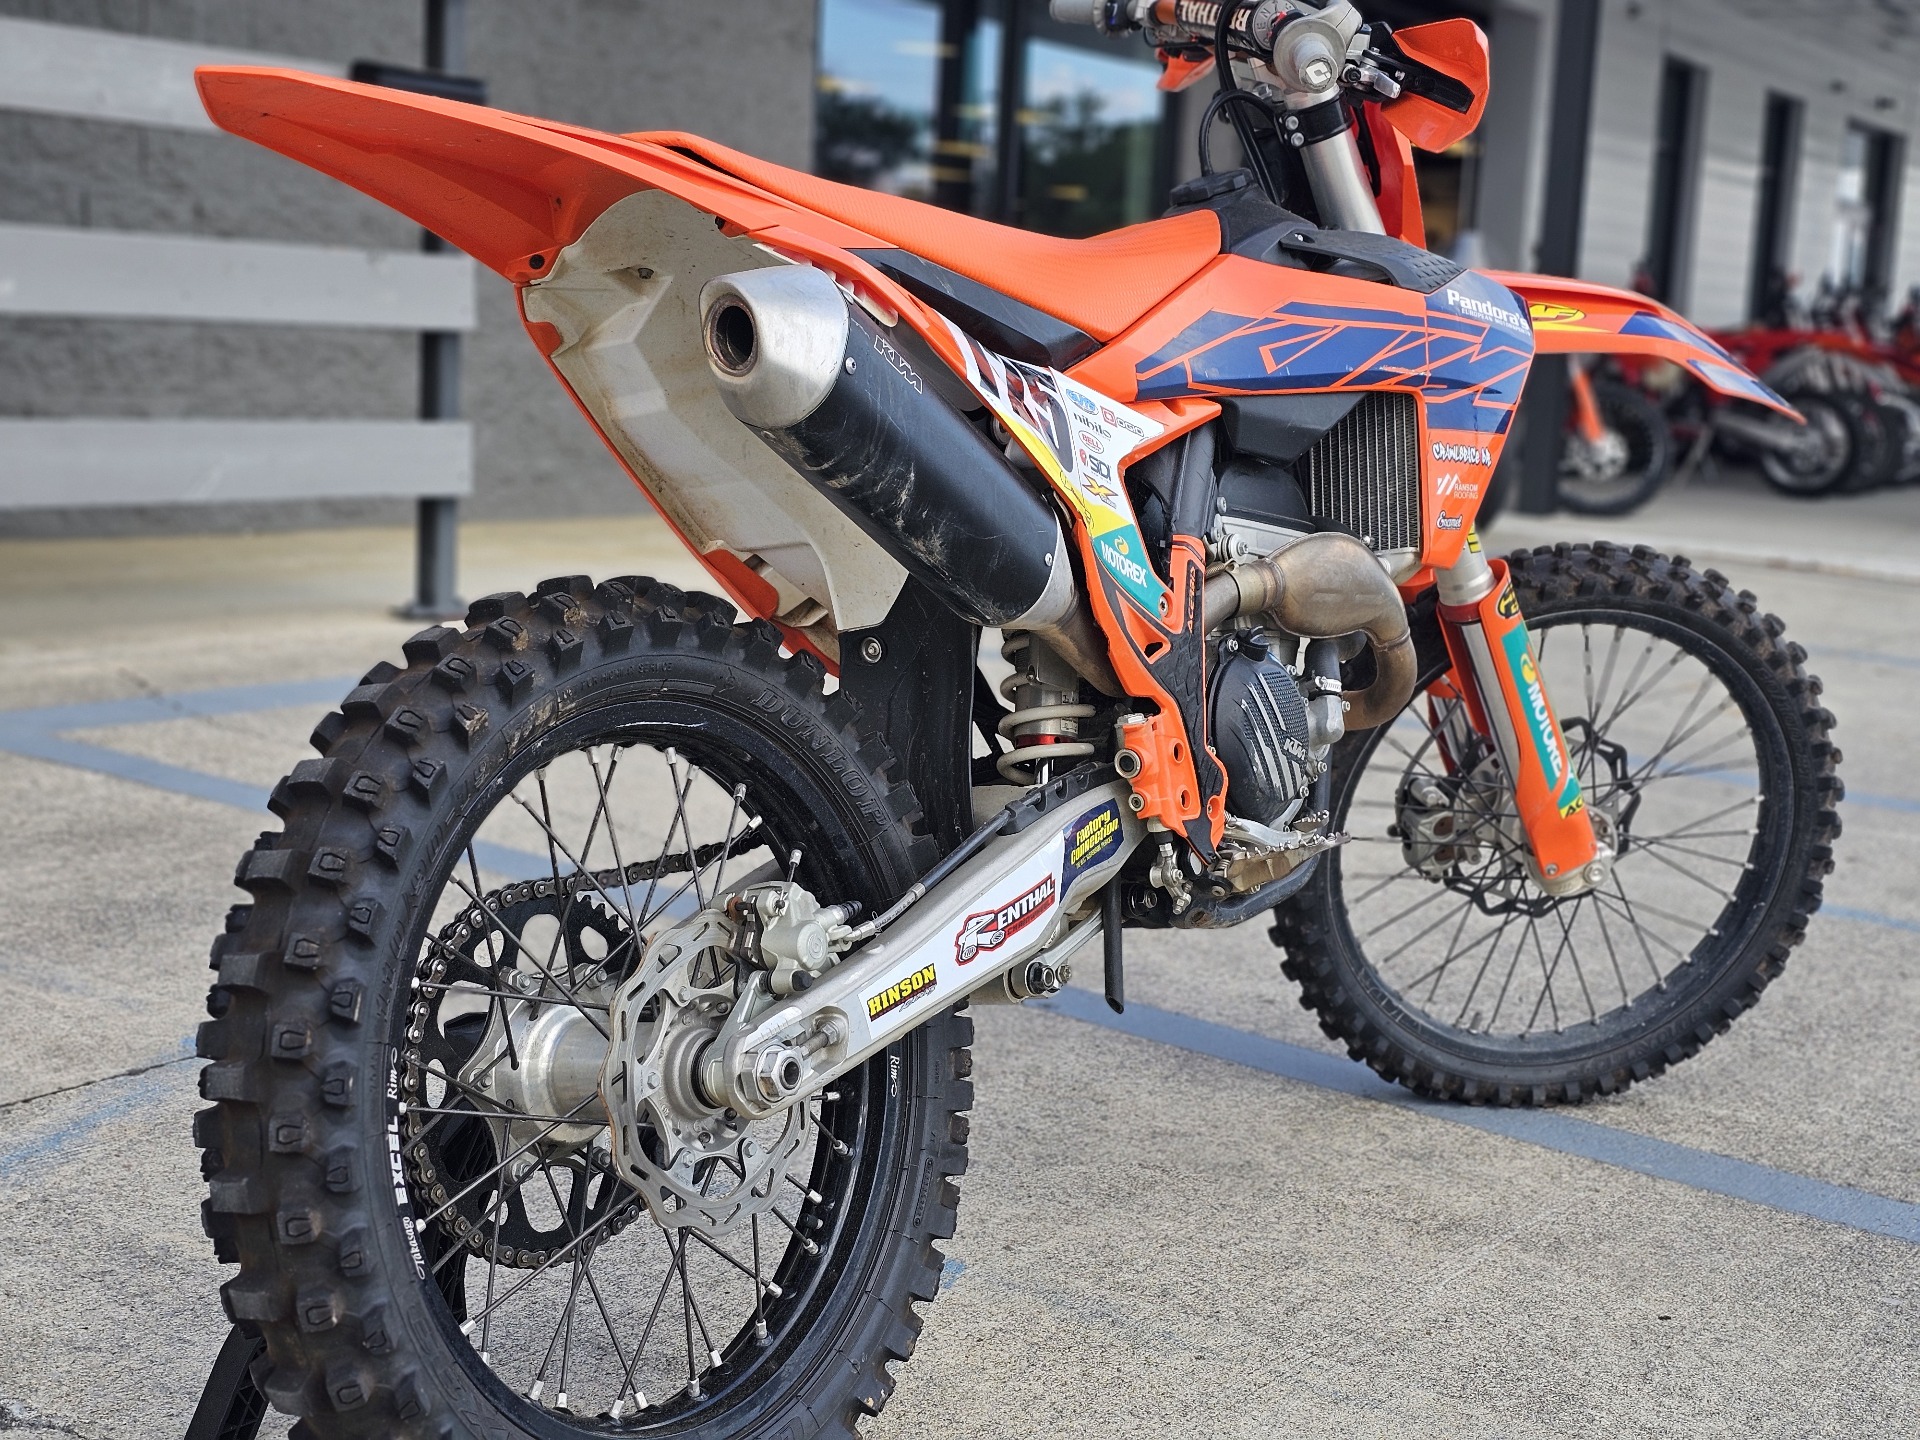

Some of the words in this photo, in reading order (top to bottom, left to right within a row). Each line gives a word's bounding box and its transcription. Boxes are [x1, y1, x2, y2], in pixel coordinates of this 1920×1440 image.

[1179, 0, 1252, 32] RTHAL
[1446, 288, 1530, 331] Pandora's
[1461, 307, 1493, 322] EUROPEAN
[873, 334, 923, 395] KTM
[1081, 433, 1103, 450] BELL
[1453, 492, 1479, 500] ROOFING
[1454, 483, 1479, 492] RANSOM
[1100, 540, 1148, 588] MOTOREX
[750, 687, 889, 827] DUNLOP
[1283, 736, 1306, 761] KTM
[867, 963, 936, 1018] HINSON
[387, 1047, 398, 1100] Rim
[889, 1055, 900, 1098] Rim
[387, 1115, 408, 1206] EXCEL
